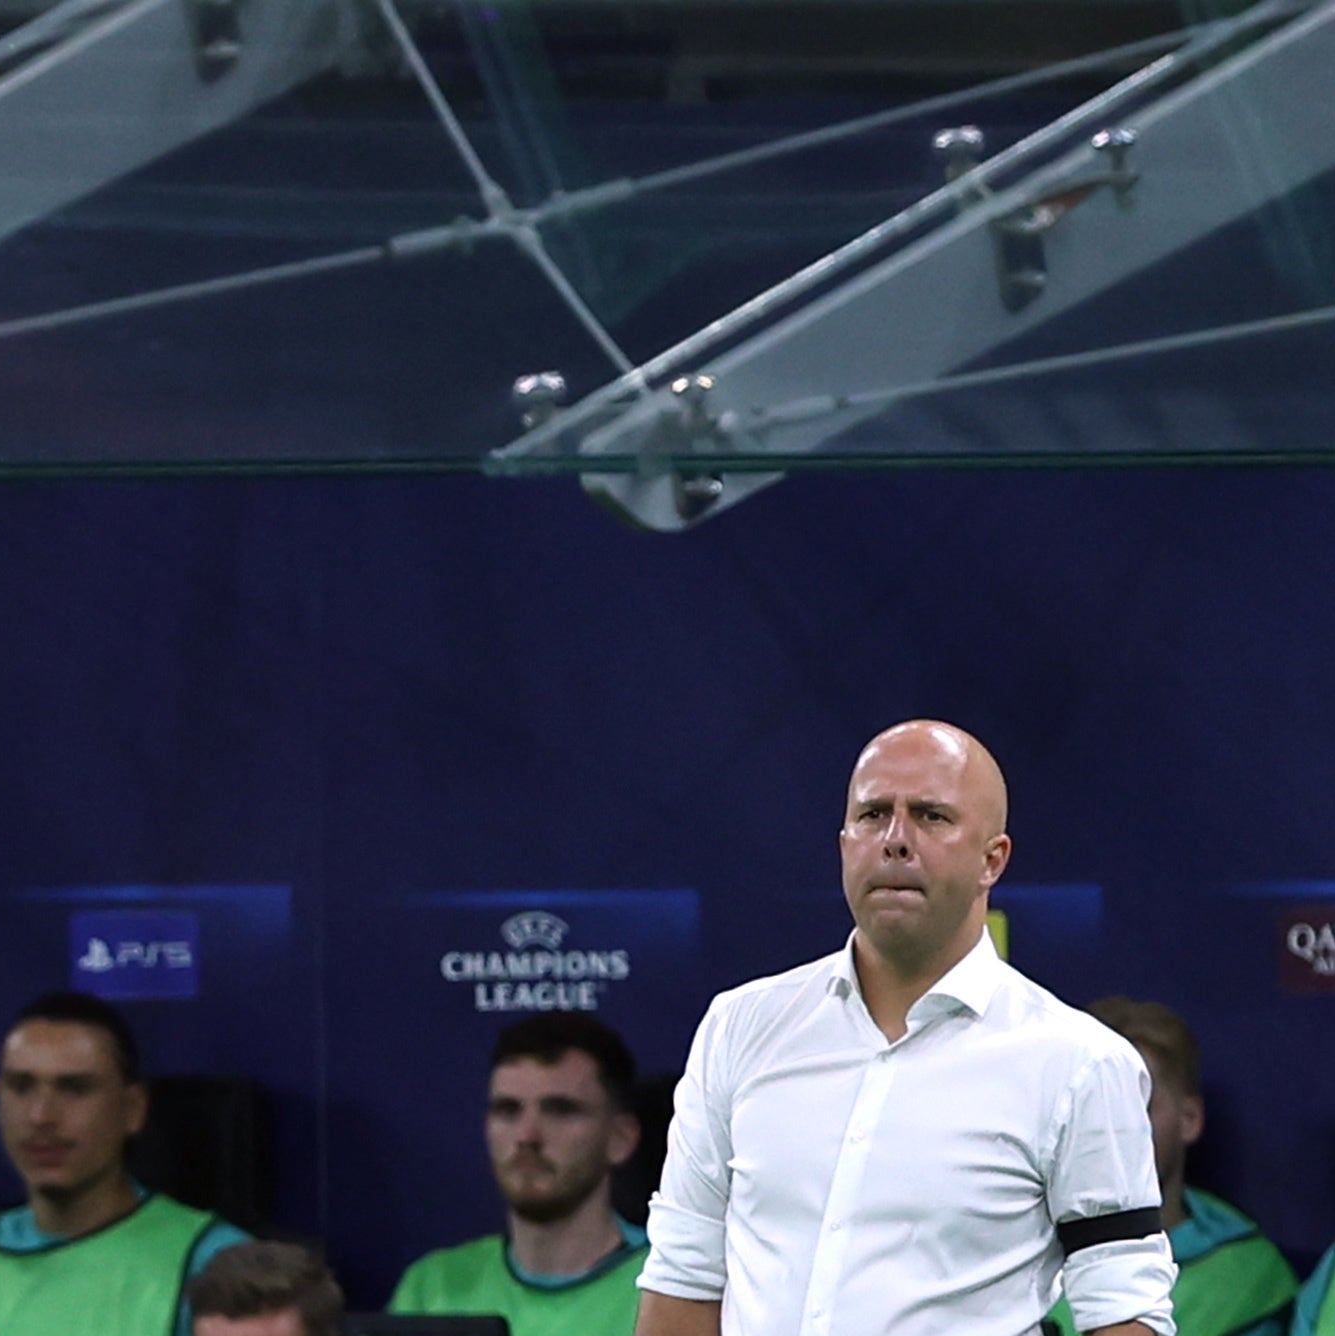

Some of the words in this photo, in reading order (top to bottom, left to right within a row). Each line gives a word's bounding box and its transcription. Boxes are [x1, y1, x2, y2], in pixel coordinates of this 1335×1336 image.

[116, 941, 192, 968] PS5
[440, 950, 630, 981] CHAMPIONS
[475, 981, 599, 1012] LEAGUE
